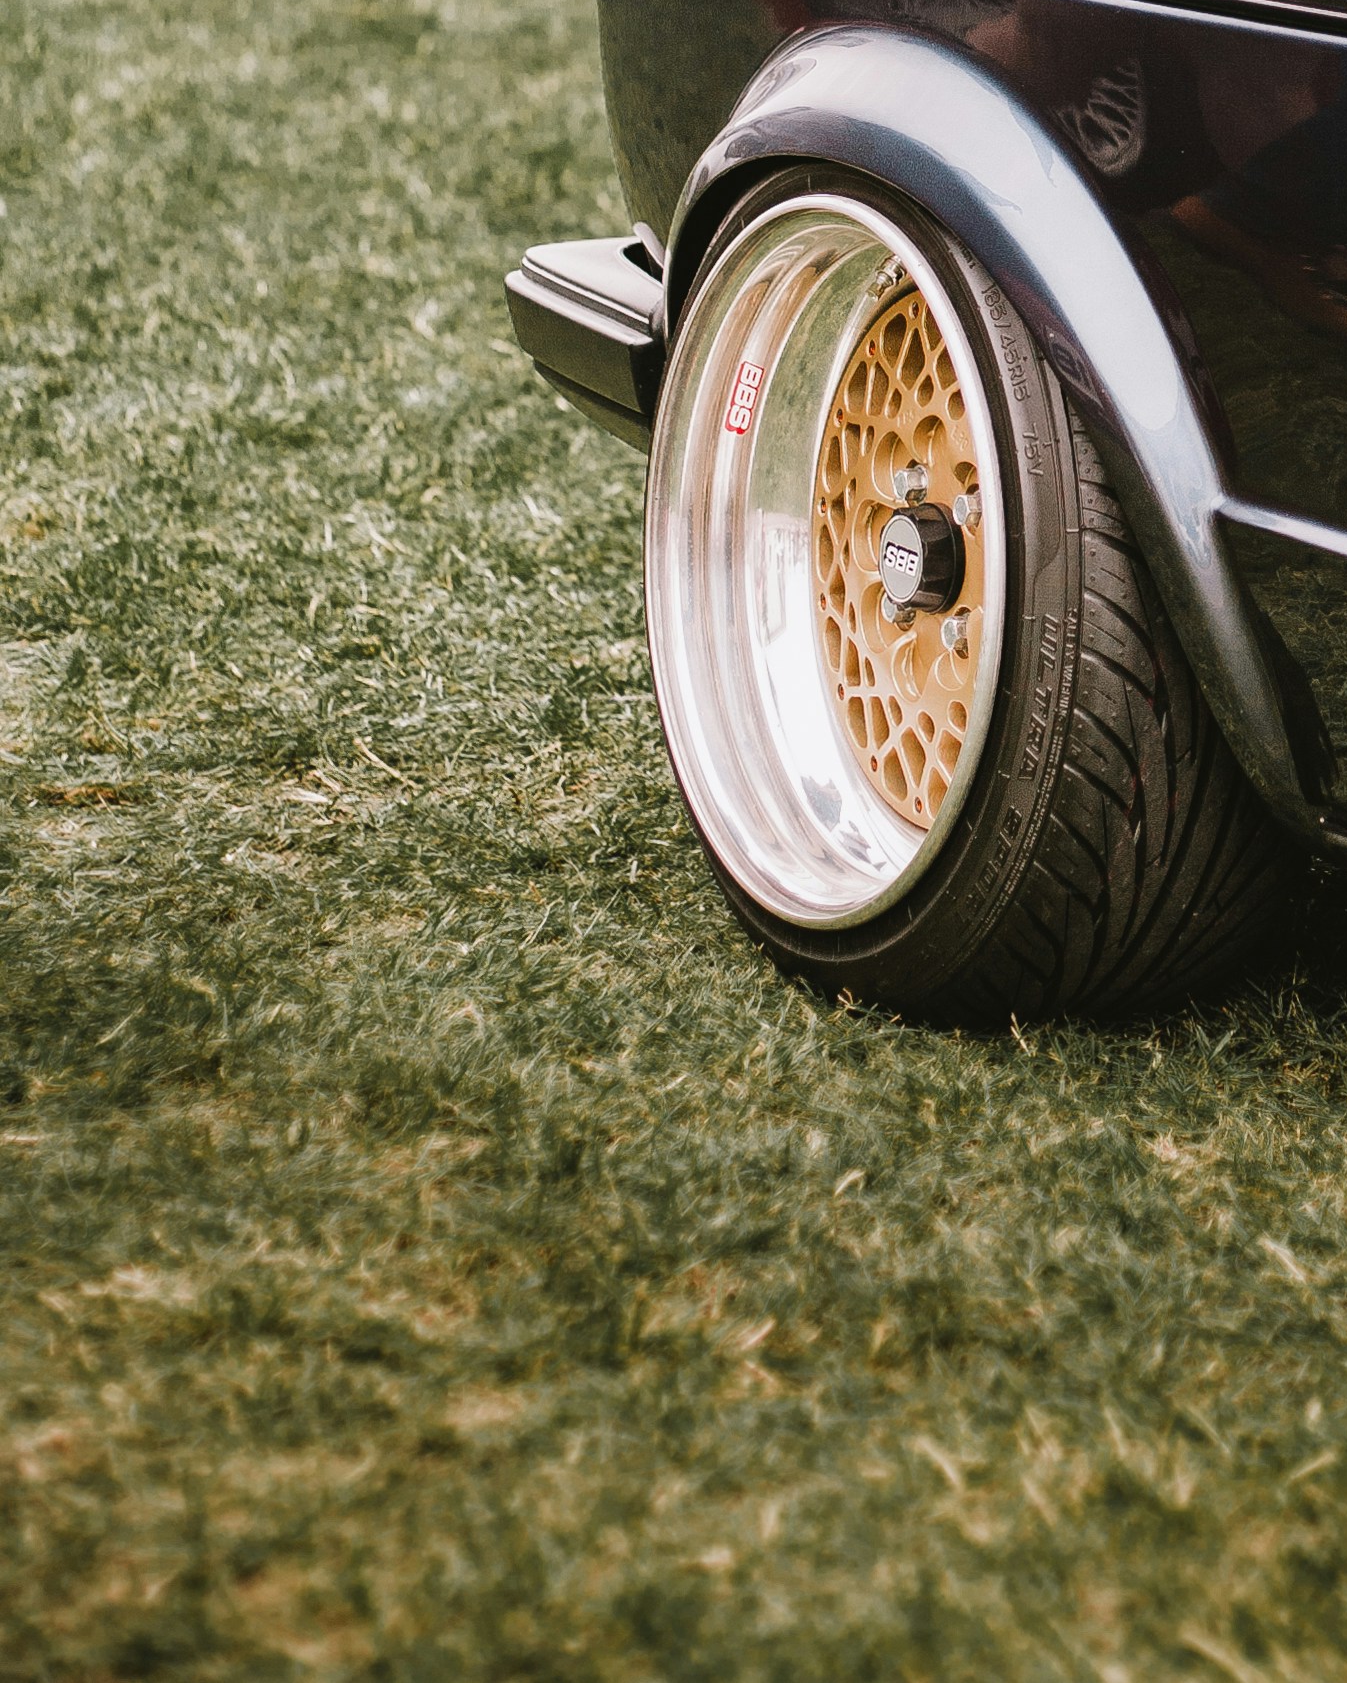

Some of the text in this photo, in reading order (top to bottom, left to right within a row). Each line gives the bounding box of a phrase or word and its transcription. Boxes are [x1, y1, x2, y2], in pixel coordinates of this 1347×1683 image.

[726, 361, 764, 433] BBS
[1022, 422, 1044, 477] 75V
[884, 541, 919, 577] BBS
